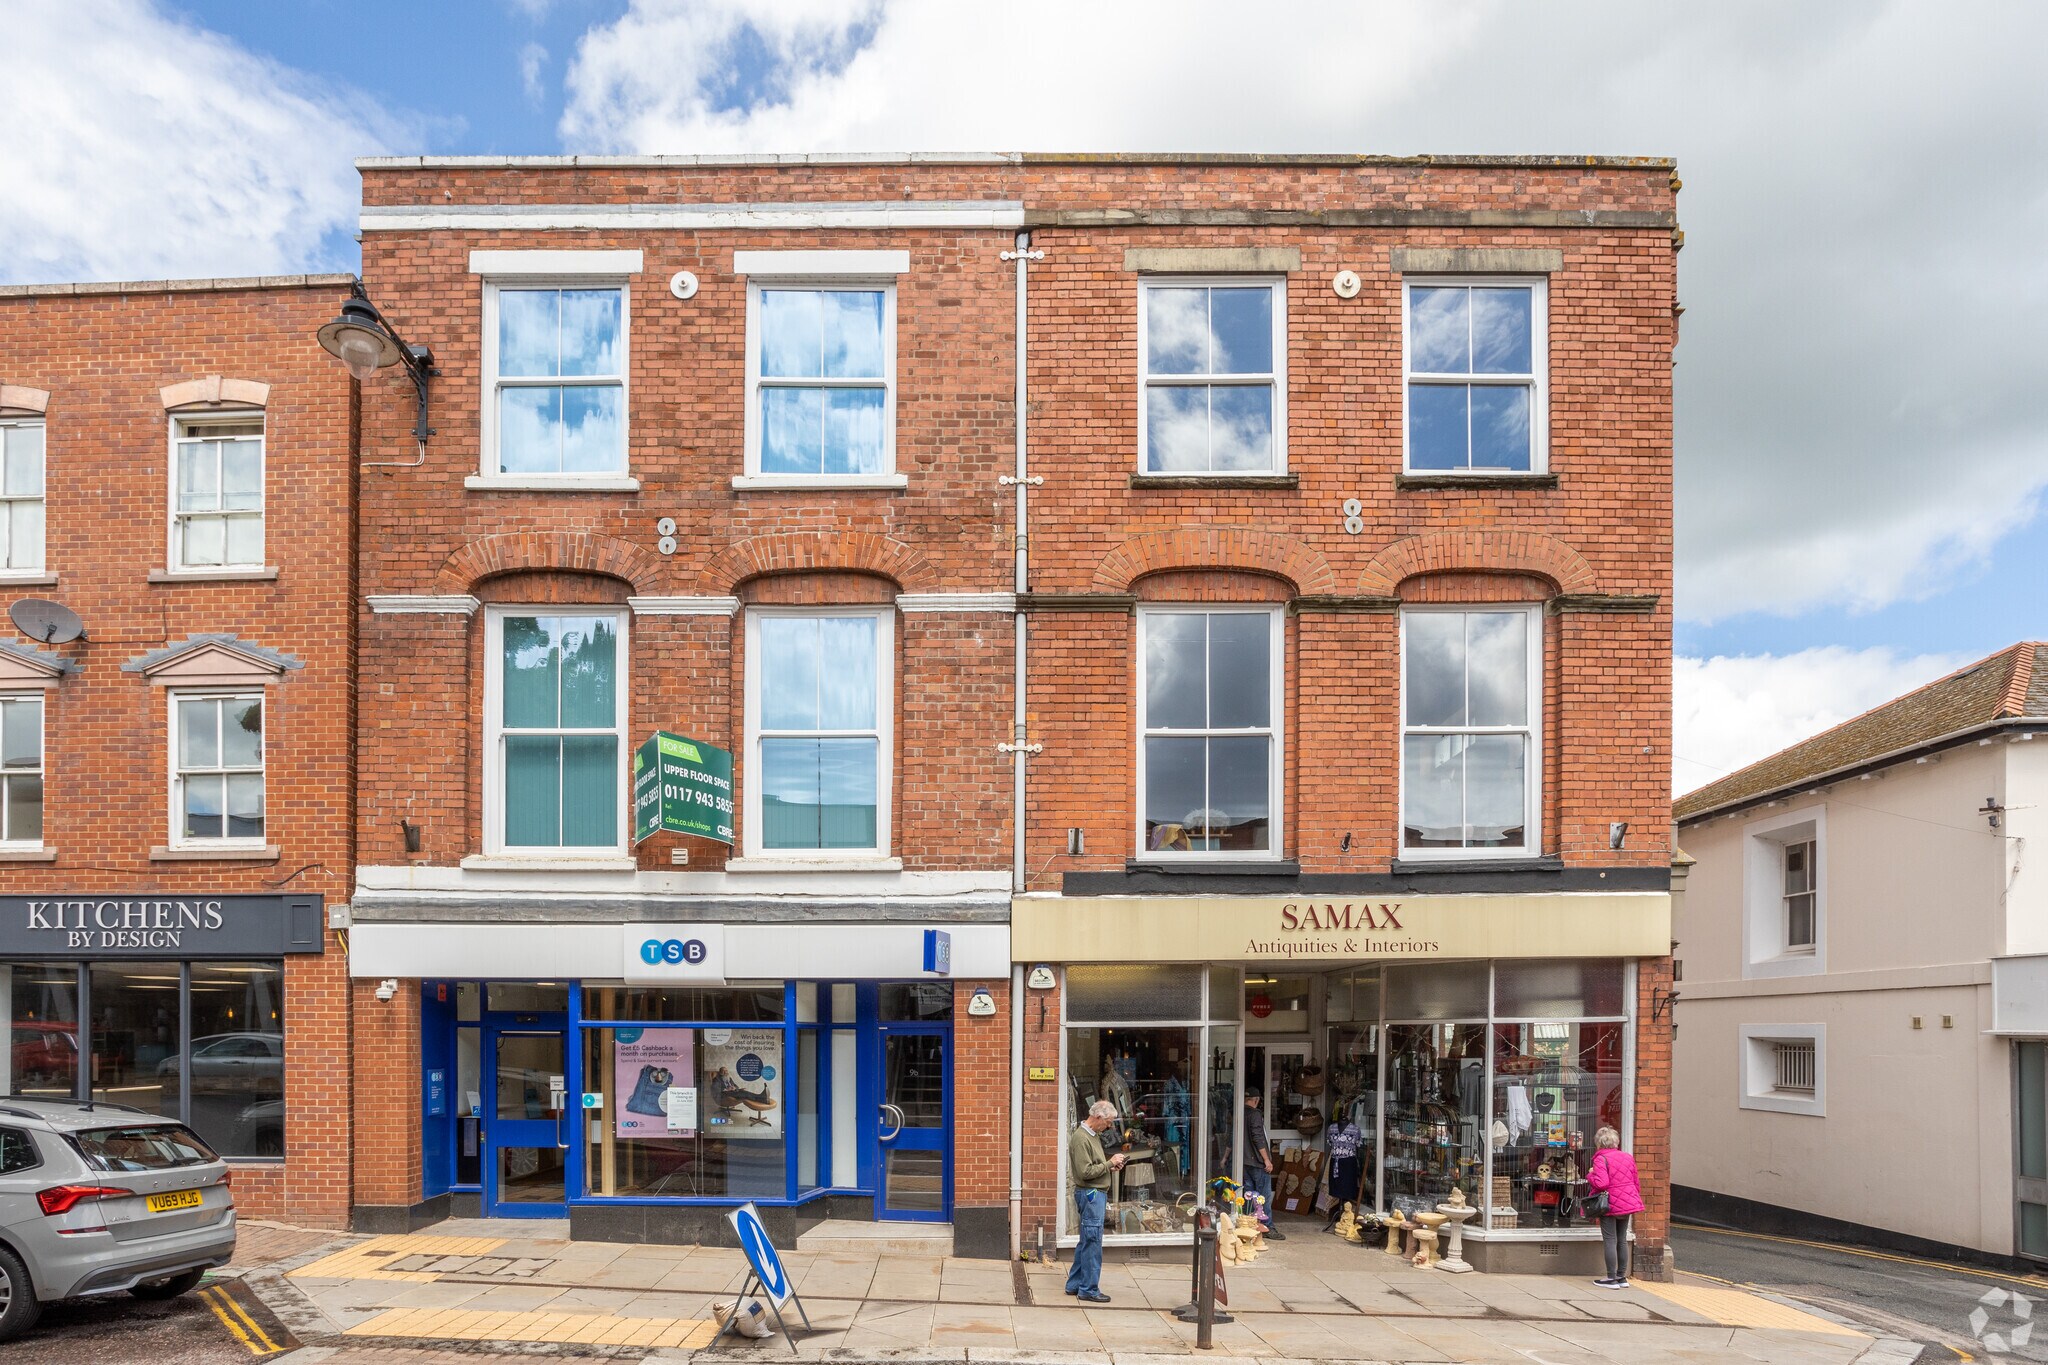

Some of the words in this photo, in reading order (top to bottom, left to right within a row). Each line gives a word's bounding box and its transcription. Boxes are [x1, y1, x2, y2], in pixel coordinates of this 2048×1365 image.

[663, 741, 677, 752] FOR
[679, 745, 694, 756] SALE
[664, 763, 689, 779] UPPER
[690, 770, 713, 785] FLOOR
[713, 777, 730, 790] SPACE
[664, 784, 692, 802] 0117
[695, 790, 713, 807] 943
[716, 796, 733, 814] 5855
[649, 814, 659, 829] CBRE
[665, 815, 711, 832] cbre.co.uk/shops
[717, 824, 733, 838] CBRE
[27, 901, 223, 930] KITCHENS
[1281, 903, 1403, 931] SAMAX
[67, 931, 95, 948] BY
[101, 931, 181, 948] DESIGN
[1245, 938, 1338, 958] Antiquities
[1343, 938, 1358, 953] &
[1364, 937, 1439, 953] Interiors
[643, 941, 704, 962] TSB
[150, 1194, 178, 1209] VU69
[180, 1191, 198, 1205] HJG
